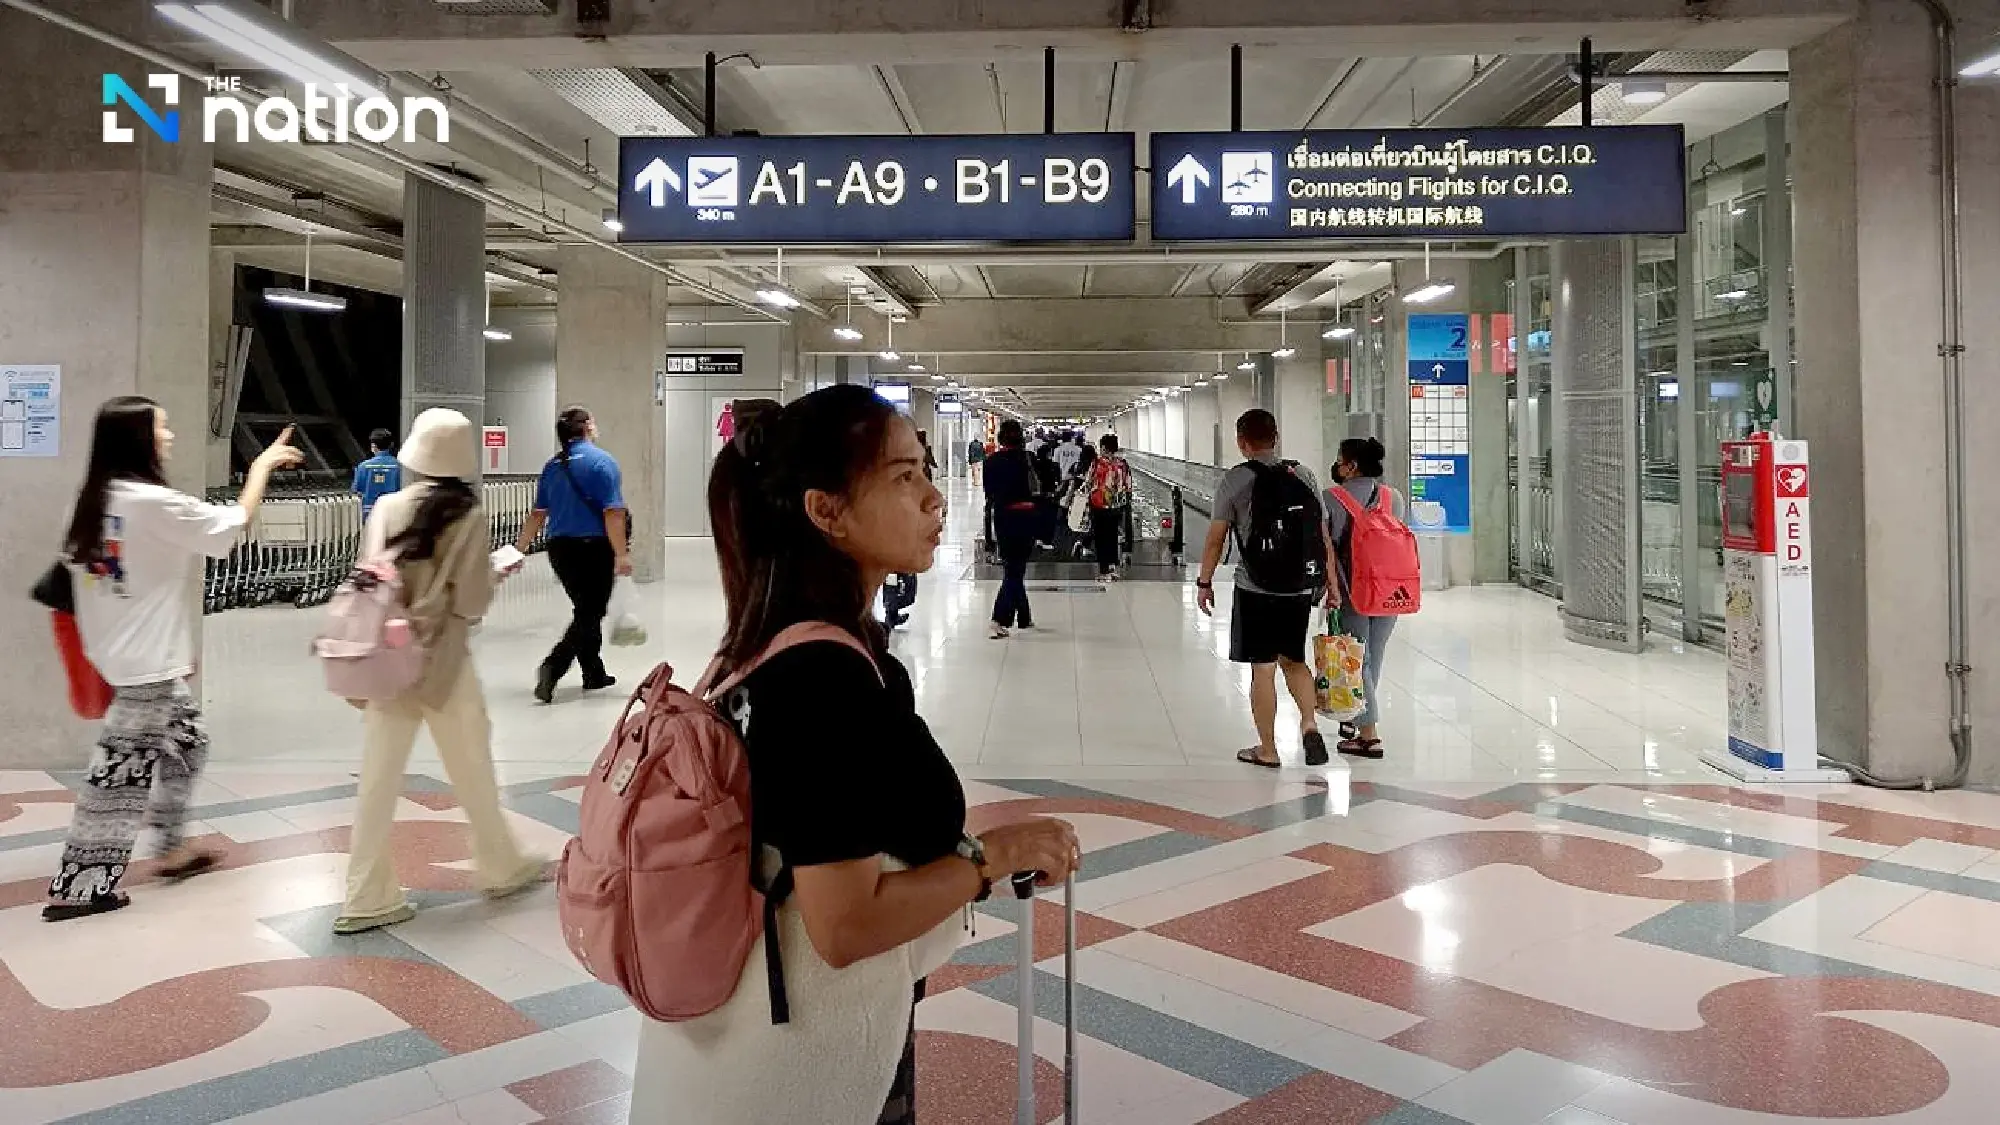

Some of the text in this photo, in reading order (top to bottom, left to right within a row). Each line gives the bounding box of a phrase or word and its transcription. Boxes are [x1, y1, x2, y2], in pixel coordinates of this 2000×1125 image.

[1538, 145, 1597, 165] C.I.Q.
[749, 161, 905, 206] A1-A9
[957, 158, 1110, 204] B1-B9
[1288, 174, 1573, 201] Connecting Flights for C.I.Q.
[1450, 327, 1466, 349] 2
[1784, 501, 1802, 561] AED
